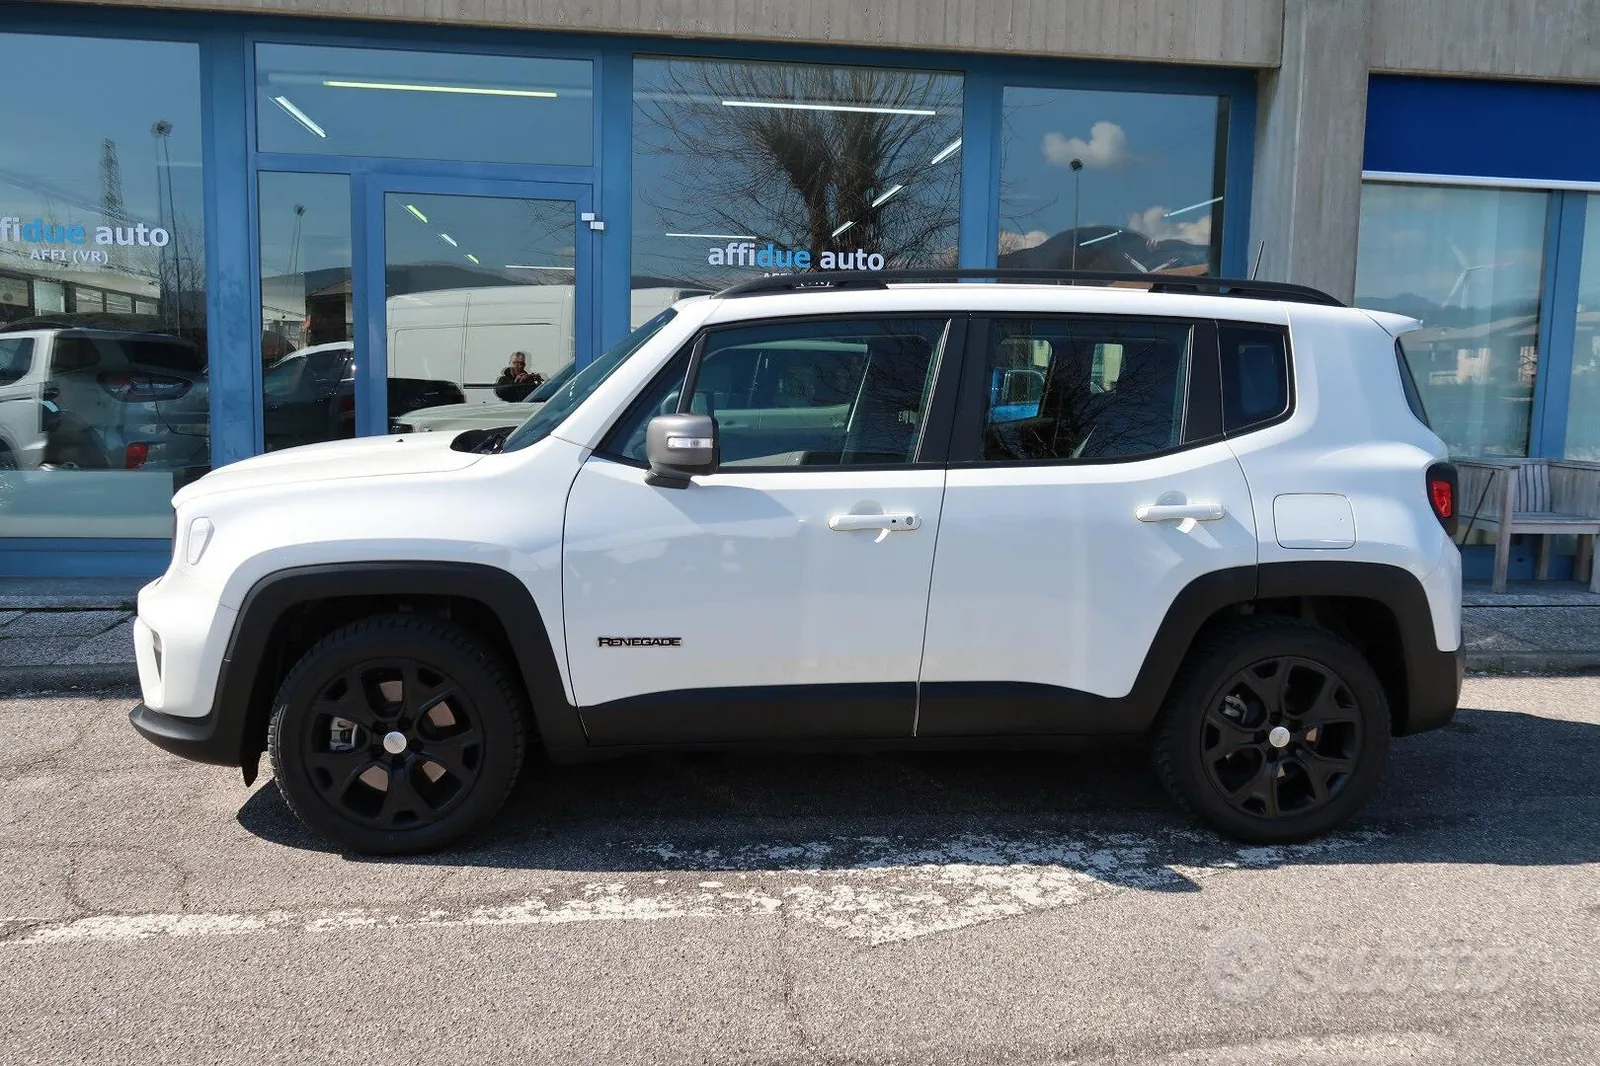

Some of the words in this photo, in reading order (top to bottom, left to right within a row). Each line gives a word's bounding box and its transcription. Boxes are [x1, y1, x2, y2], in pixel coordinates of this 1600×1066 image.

[95, 223, 170, 247] auto
[30, 250, 68, 262] AFFI
[73, 251, 109, 265] (VR)
[708, 243, 811, 269] affidue
[820, 249, 885, 271] auto
[598, 637, 682, 647] RENEGADE
